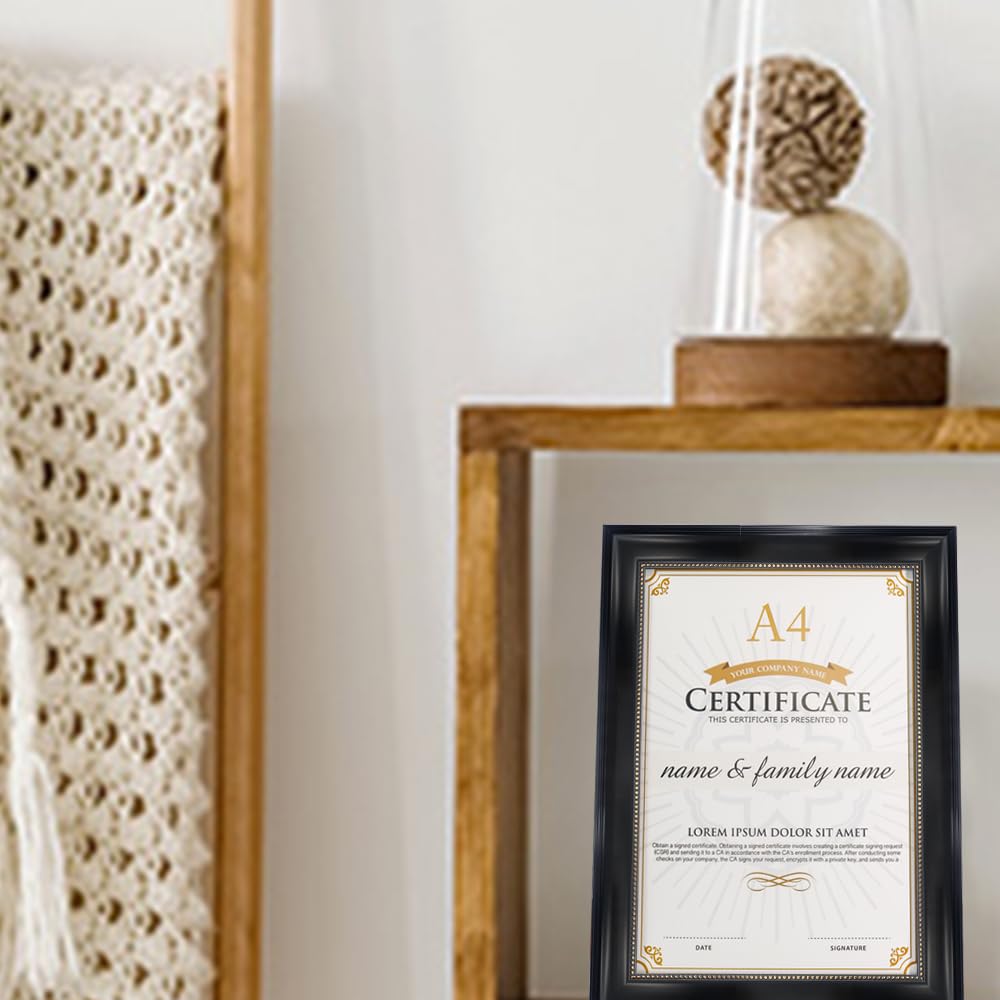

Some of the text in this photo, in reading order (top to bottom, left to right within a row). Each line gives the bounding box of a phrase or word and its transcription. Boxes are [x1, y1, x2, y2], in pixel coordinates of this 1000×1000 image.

[746, 603, 811, 642] A4
[730, 664, 827, 679] YOUR COMPANY NAME
[686, 687, 871, 712] CERTIFICATE
[709, 716, 727, 724] THIS
[729, 716, 779, 724] CERTIFICATE
[660, 755, 895, 788] name & family name
[688, 827, 868, 838] LOREM IPSUM DOLOR SIT AMET
[719, 842, 743, 850] Obtaining
